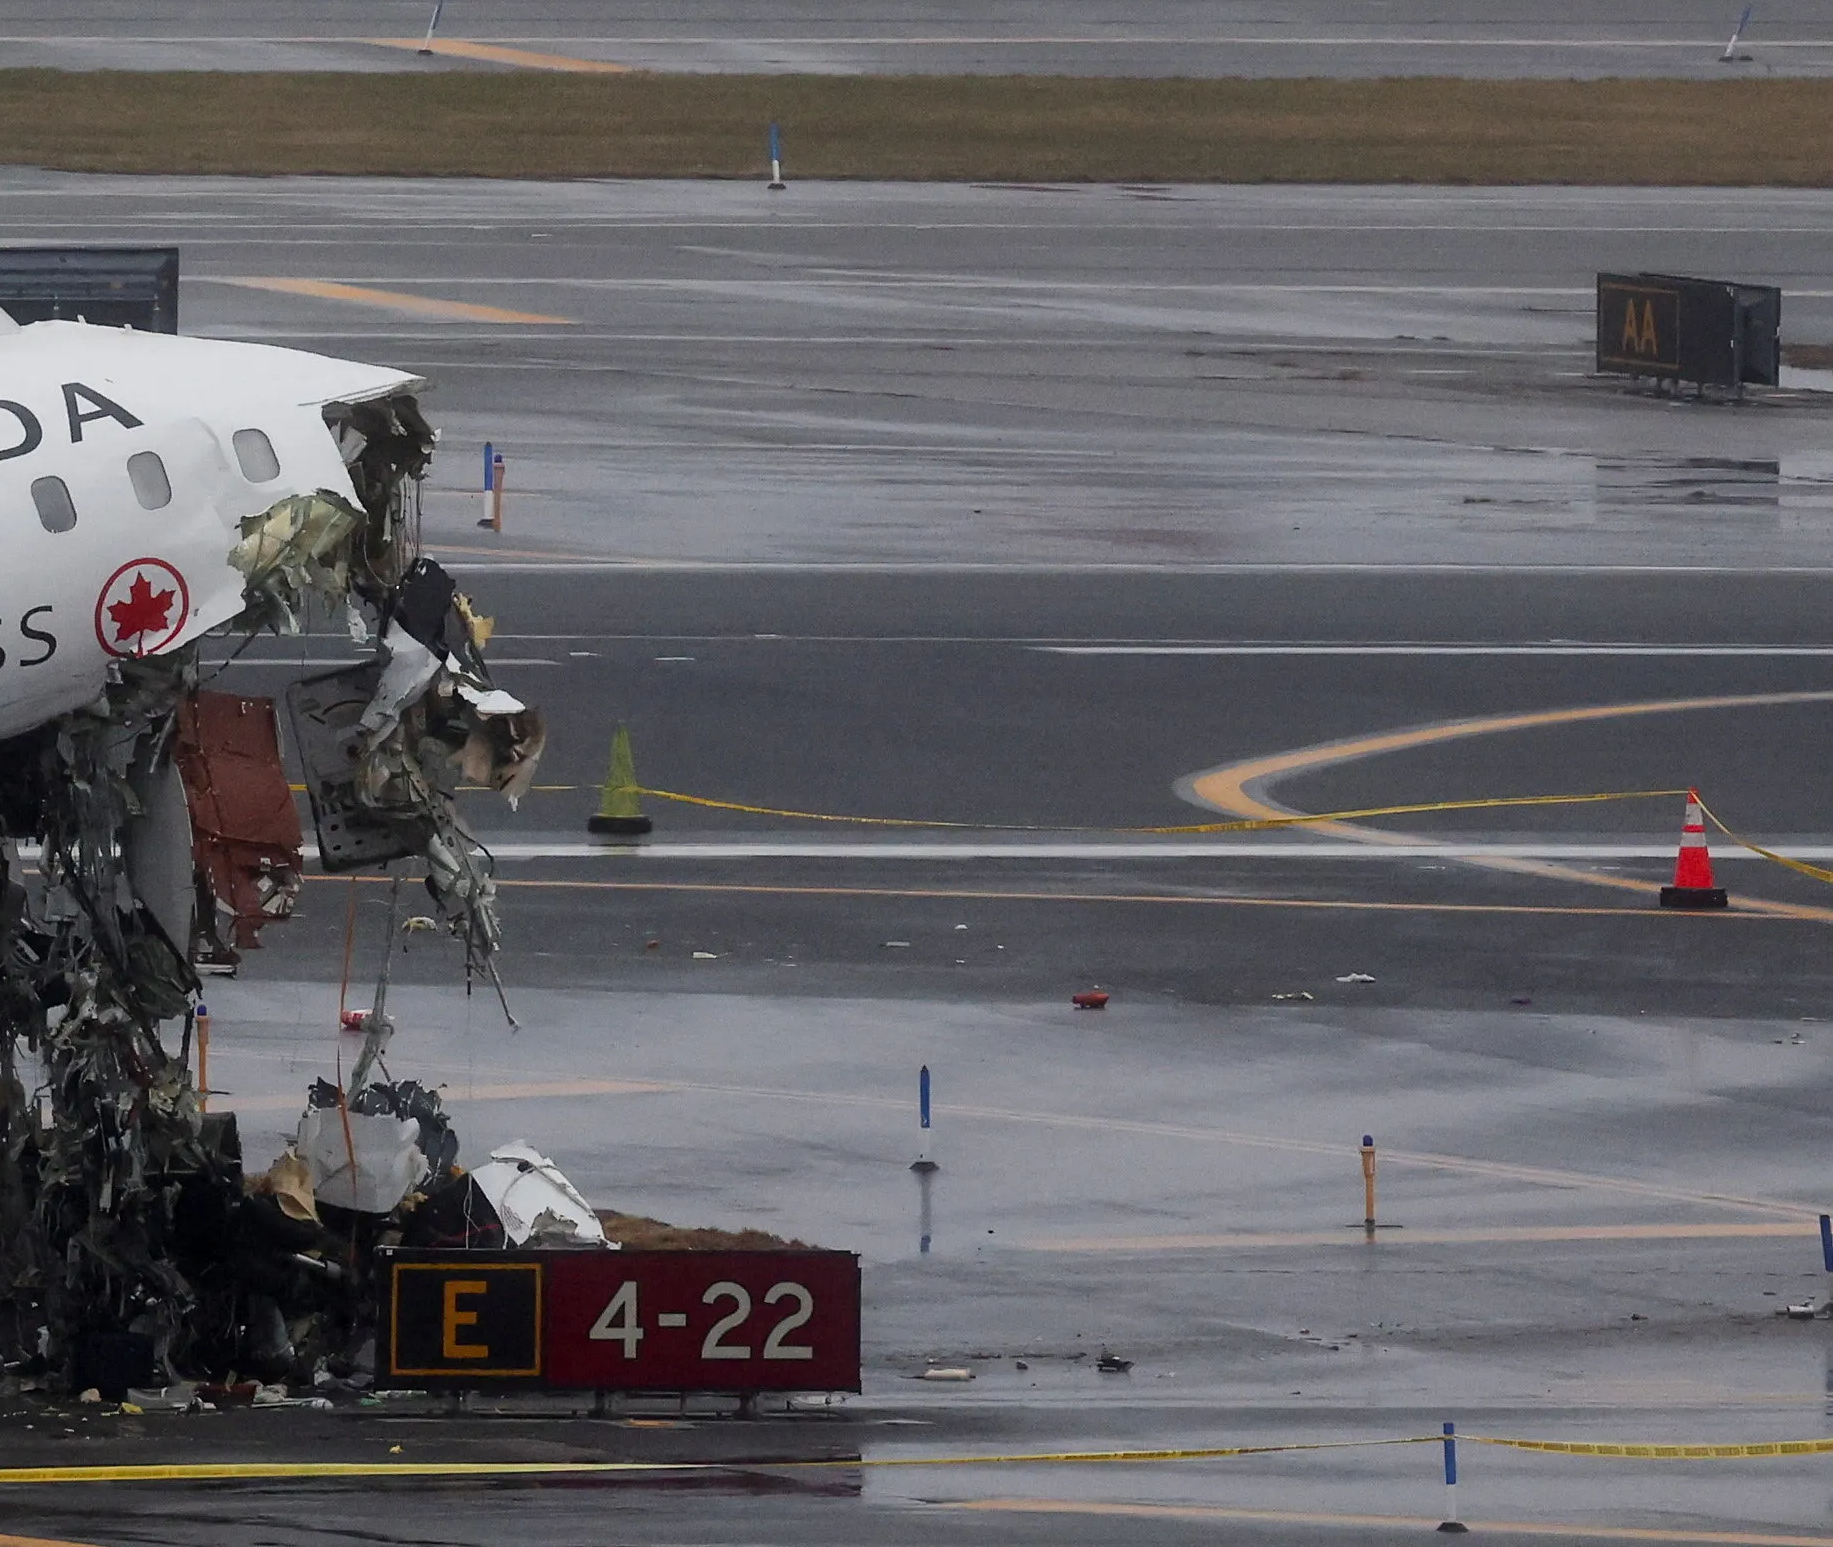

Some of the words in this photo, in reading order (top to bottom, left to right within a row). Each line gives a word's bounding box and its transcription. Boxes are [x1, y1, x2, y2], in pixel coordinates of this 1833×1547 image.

[1623, 298, 1657, 355] AA
[443, 1280, 489, 1359] E
[588, 1280, 815, 1360] 4-22
